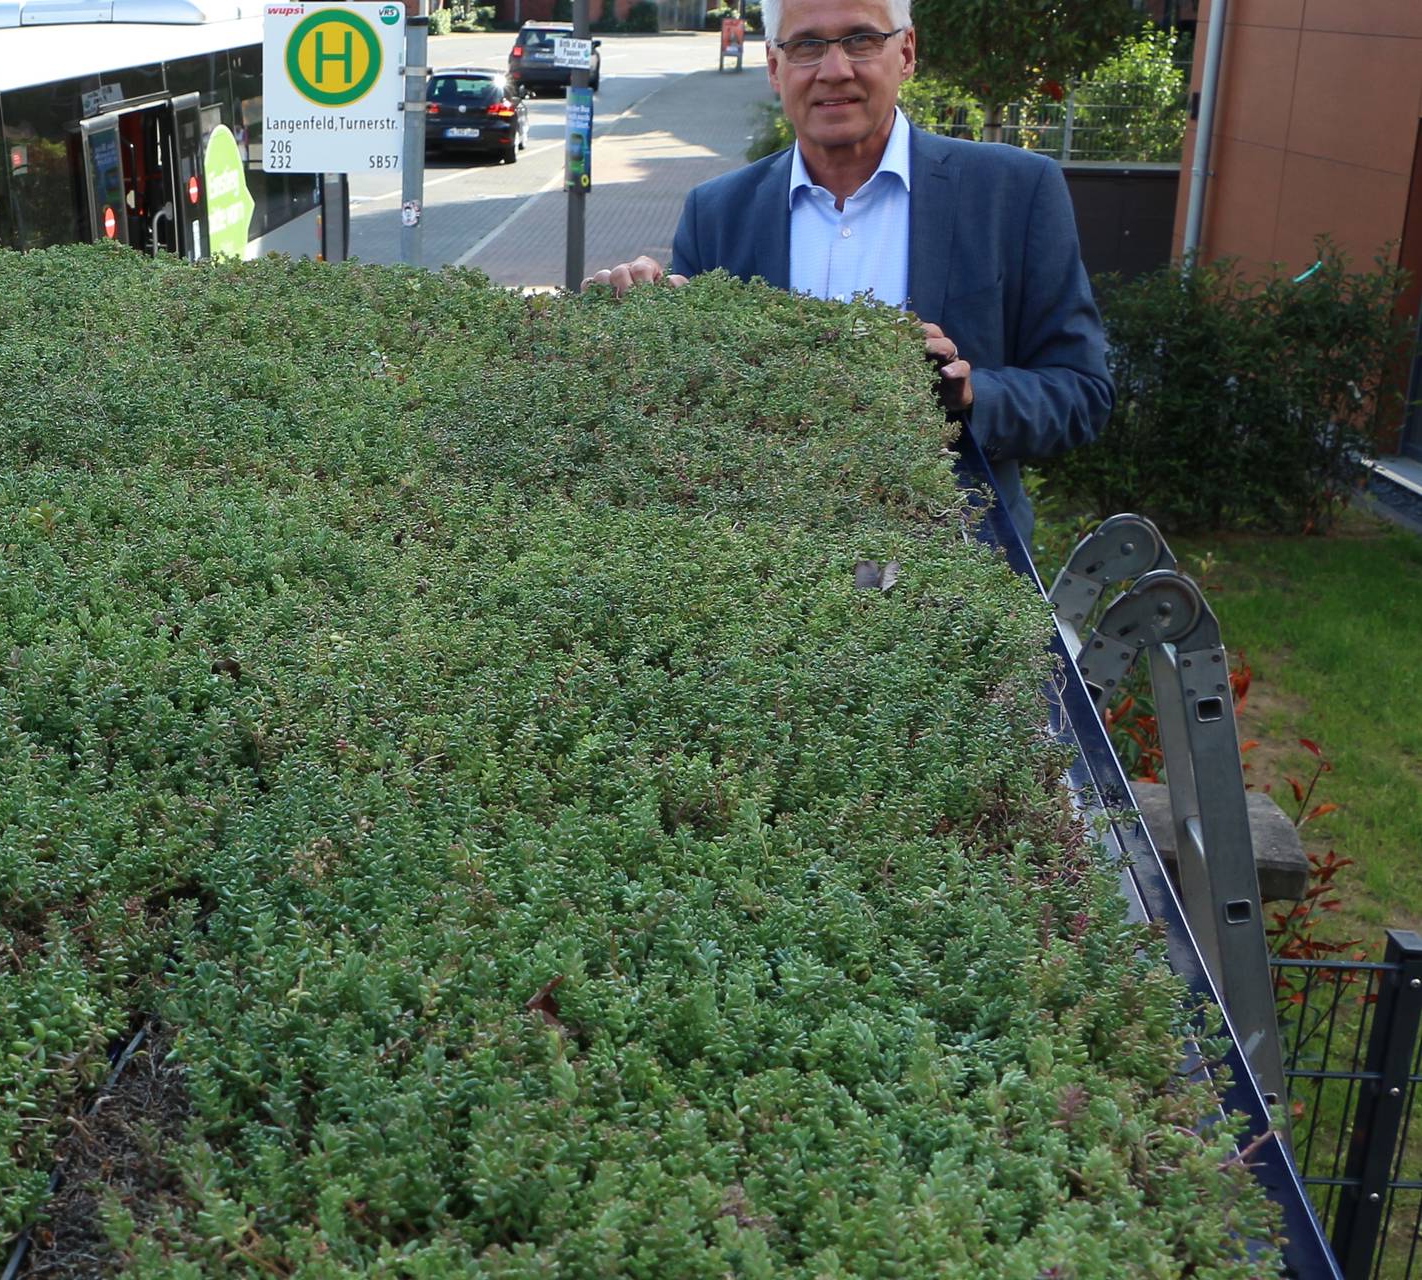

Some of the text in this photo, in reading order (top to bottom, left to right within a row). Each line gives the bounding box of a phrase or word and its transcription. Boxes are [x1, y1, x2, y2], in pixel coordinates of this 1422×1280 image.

[267, 4, 305, 17] wupsi
[315, 31, 352, 83] H
[269, 140, 292, 154] 206
[269, 156, 292, 169] 232
[369, 156, 399, 169] SB57
